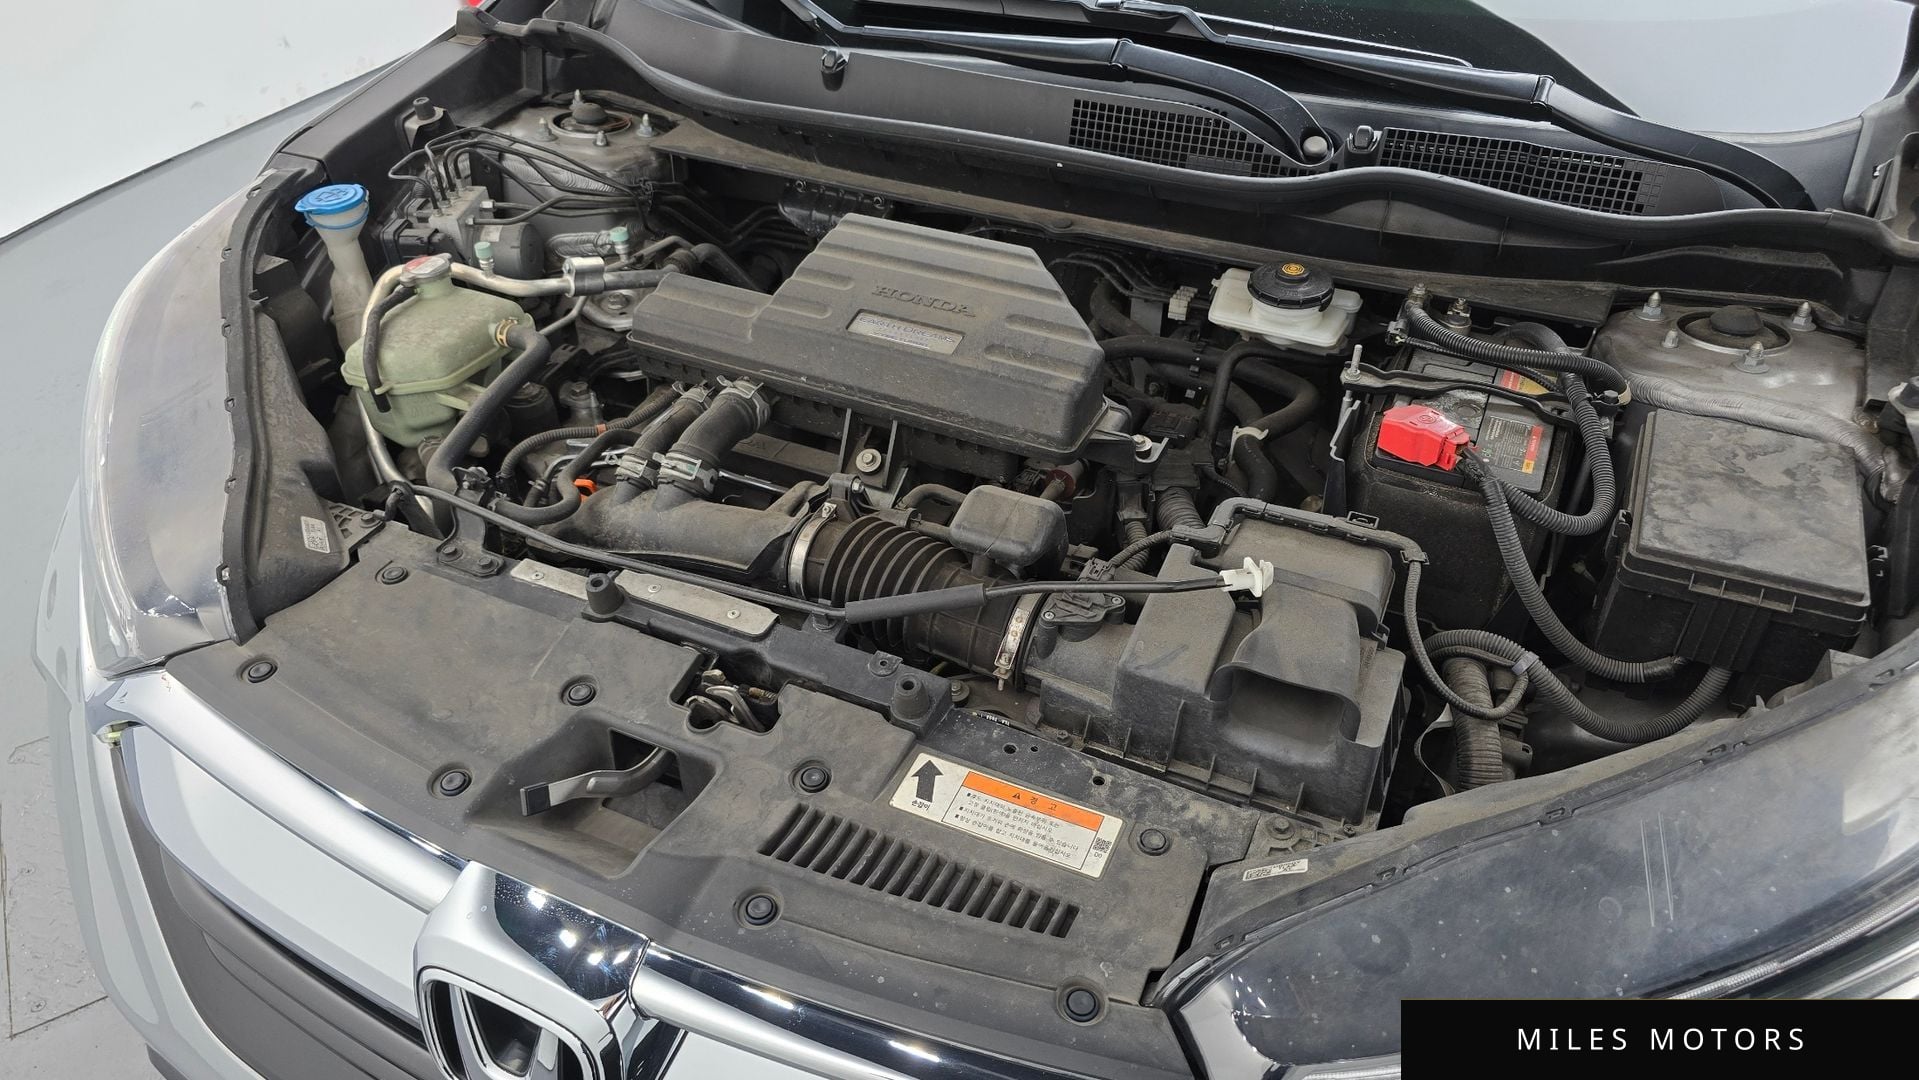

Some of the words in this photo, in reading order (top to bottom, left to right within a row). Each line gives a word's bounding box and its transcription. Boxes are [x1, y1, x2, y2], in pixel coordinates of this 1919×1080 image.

[871, 285, 976, 317] HONDA
[911, 800, 931, 812] 손잡이
[1030, 797, 1038, 805] 경
[1048, 802, 1057, 811] 고
